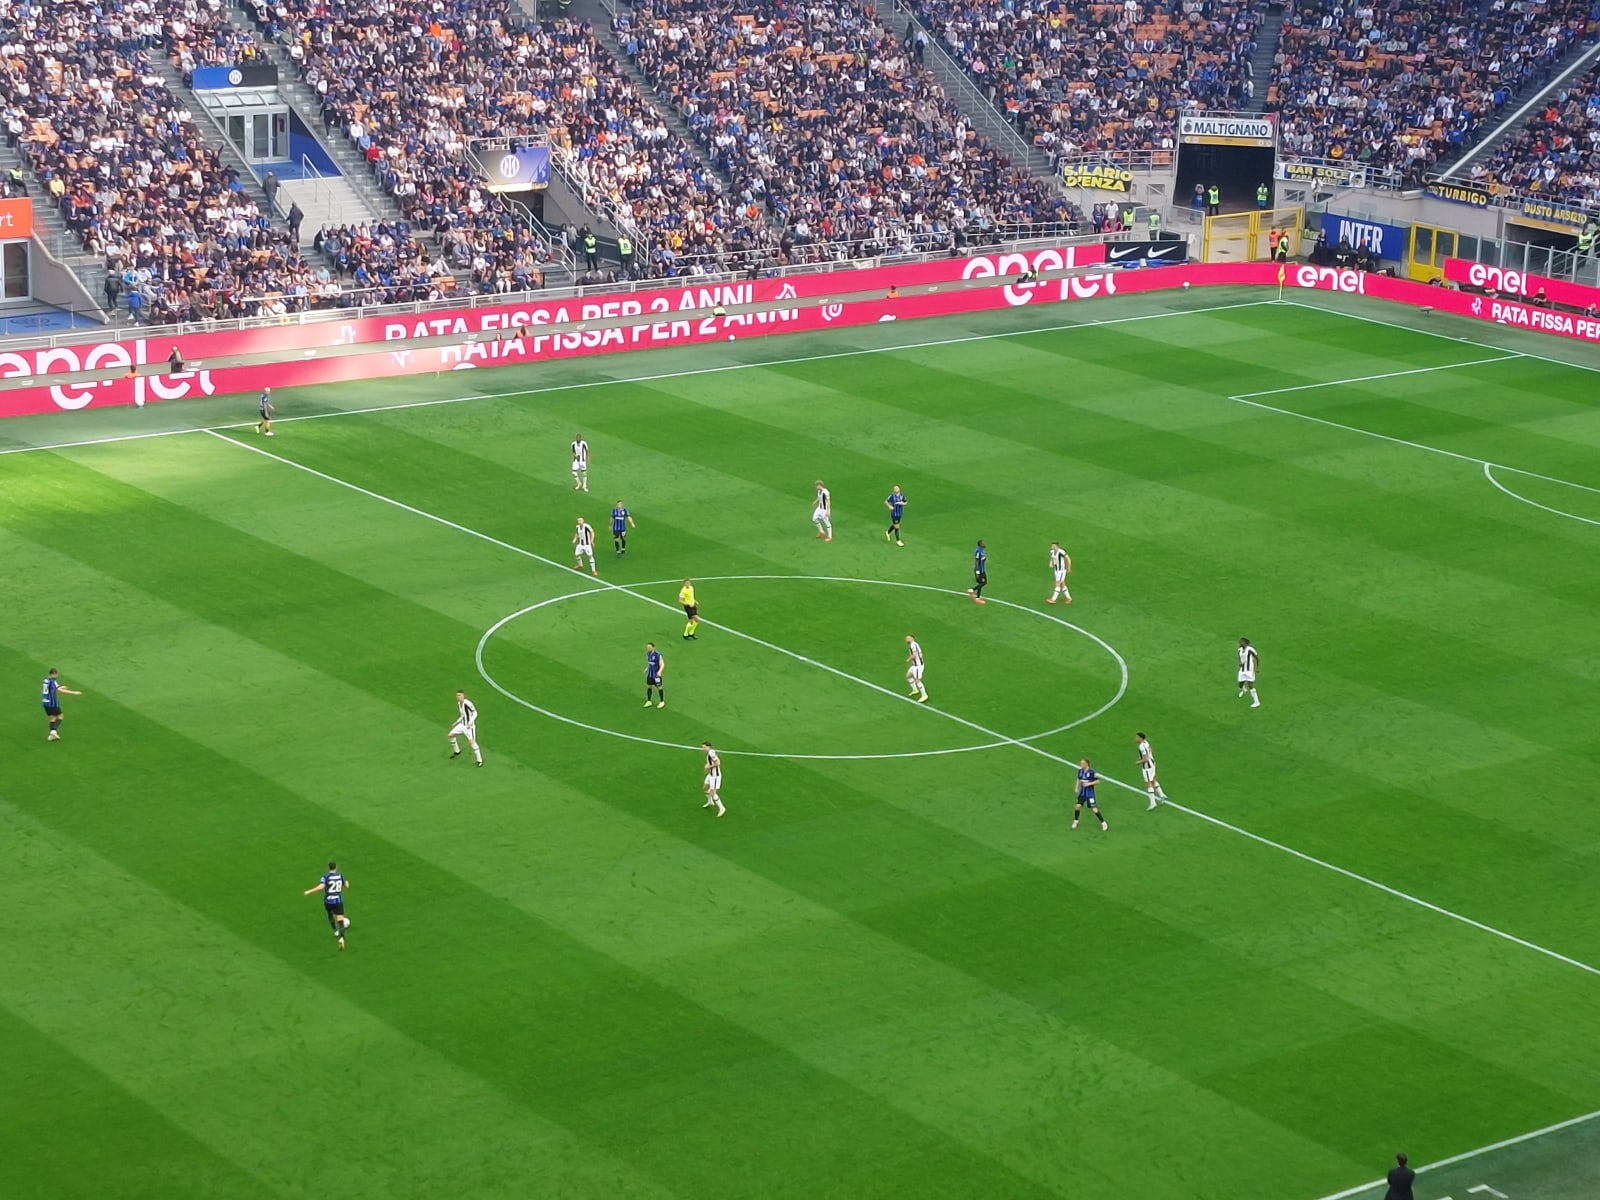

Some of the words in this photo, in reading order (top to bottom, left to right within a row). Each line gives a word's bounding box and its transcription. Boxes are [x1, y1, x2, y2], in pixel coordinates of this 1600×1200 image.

[1193, 121, 1269, 138] MALTIGNANO
[1287, 165, 1314, 175] BAR
[1316, 168, 1349, 179] SOLE
[1066, 176, 1126, 192] D'ENZA
[1438, 185, 1488, 206] TURBIGO
[1524, 202, 1552, 216] BUSTO
[1339, 219, 1383, 254] INTER
[1297, 265, 1365, 295] enel
[1469, 264, 1528, 296] enel
[1491, 302, 1528, 325] RATA
[1532, 310, 1573, 334] FISSA
[328, 879, 343, 894] 28
